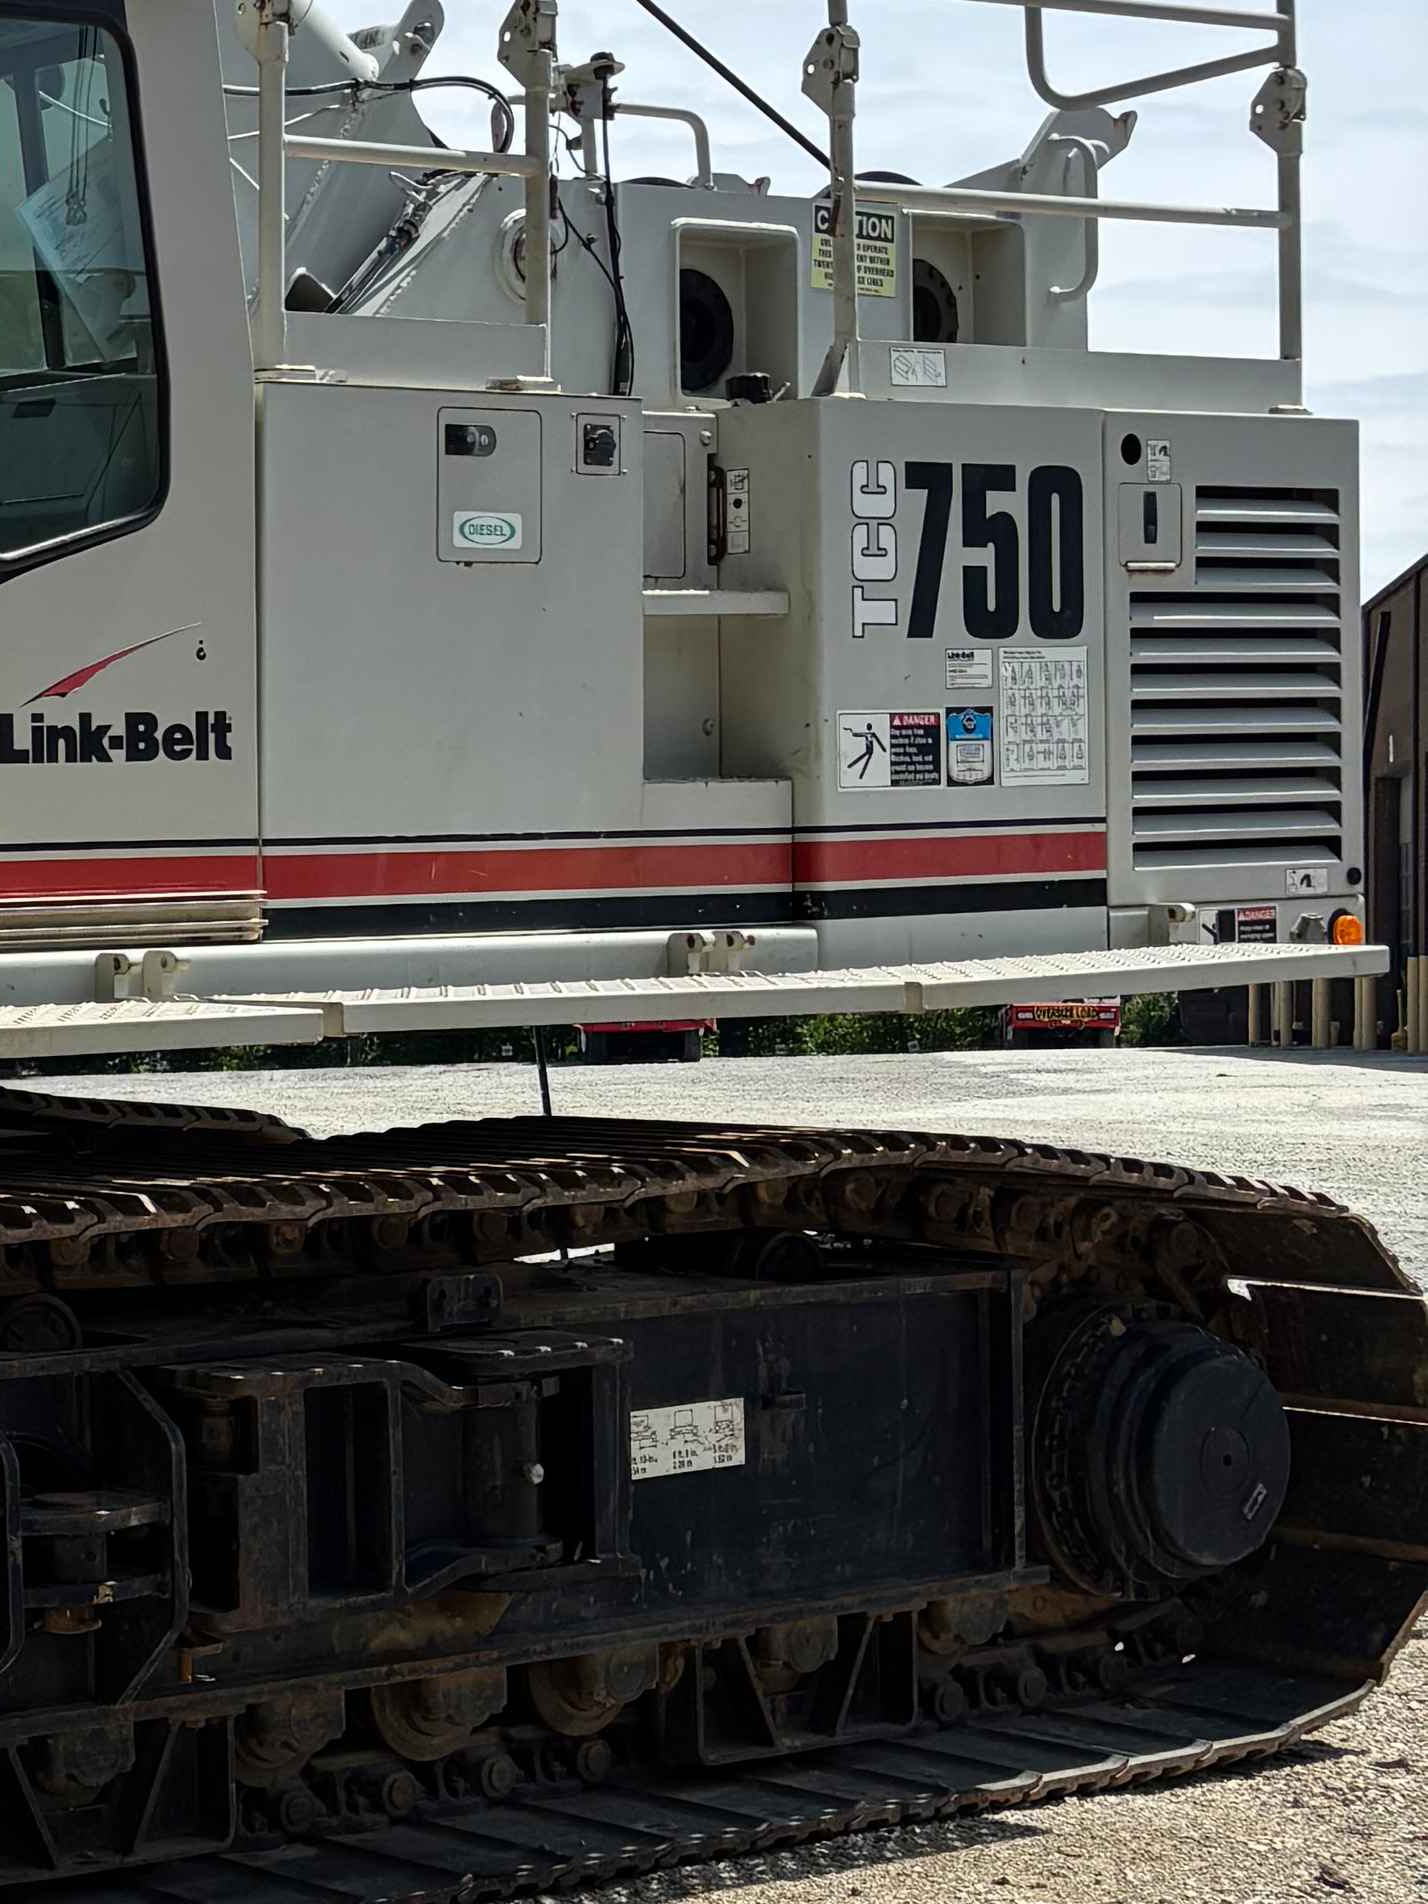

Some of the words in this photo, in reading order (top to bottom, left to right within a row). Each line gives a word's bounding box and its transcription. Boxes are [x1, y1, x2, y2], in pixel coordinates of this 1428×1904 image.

[816, 209, 893, 240] CTION
[468, 523, 507, 537] DIESEL
[850, 460, 898, 639] TCC
[904, 461, 1085, 640] 750
